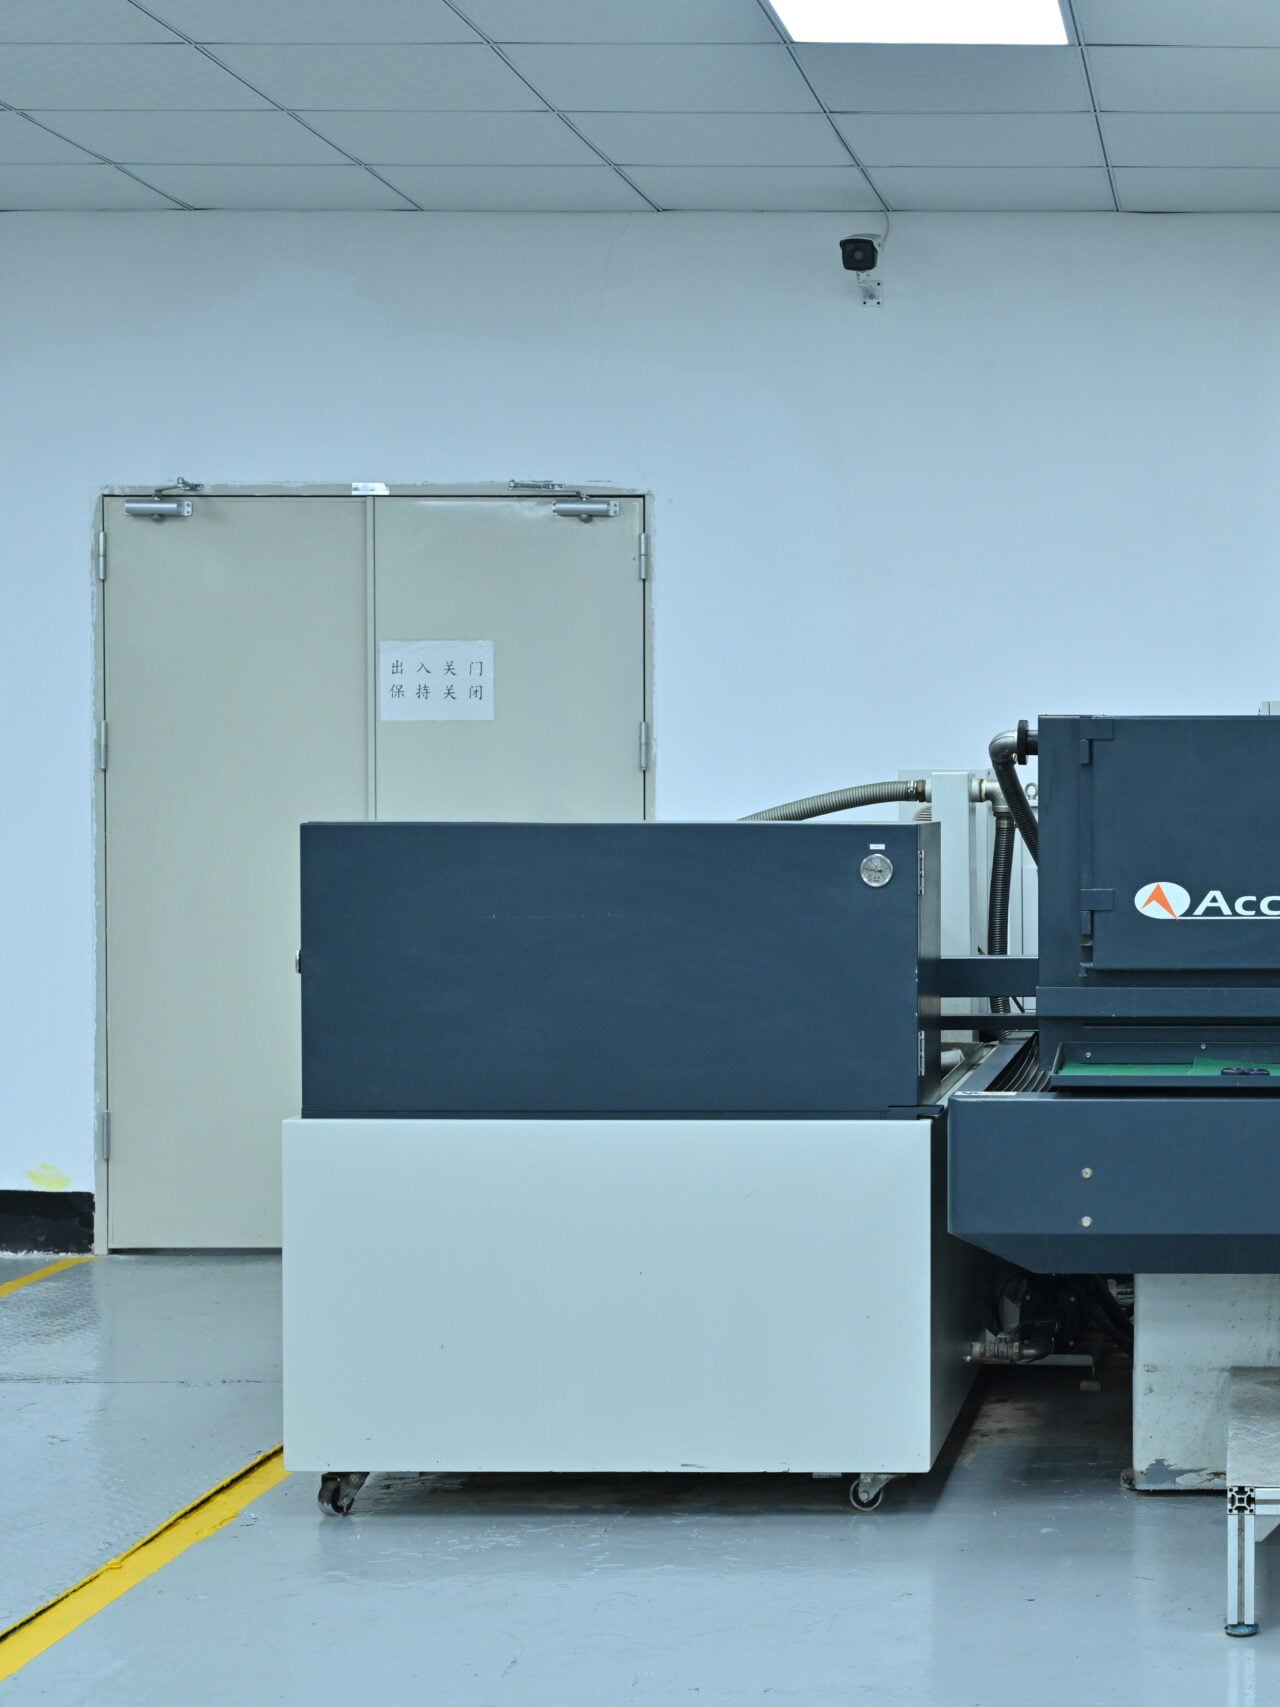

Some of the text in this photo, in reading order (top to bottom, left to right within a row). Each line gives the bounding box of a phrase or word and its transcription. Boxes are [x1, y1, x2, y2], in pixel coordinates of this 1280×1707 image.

[391, 659, 484, 677] 出入关门
[390, 683, 484, 701] 保持关闭
